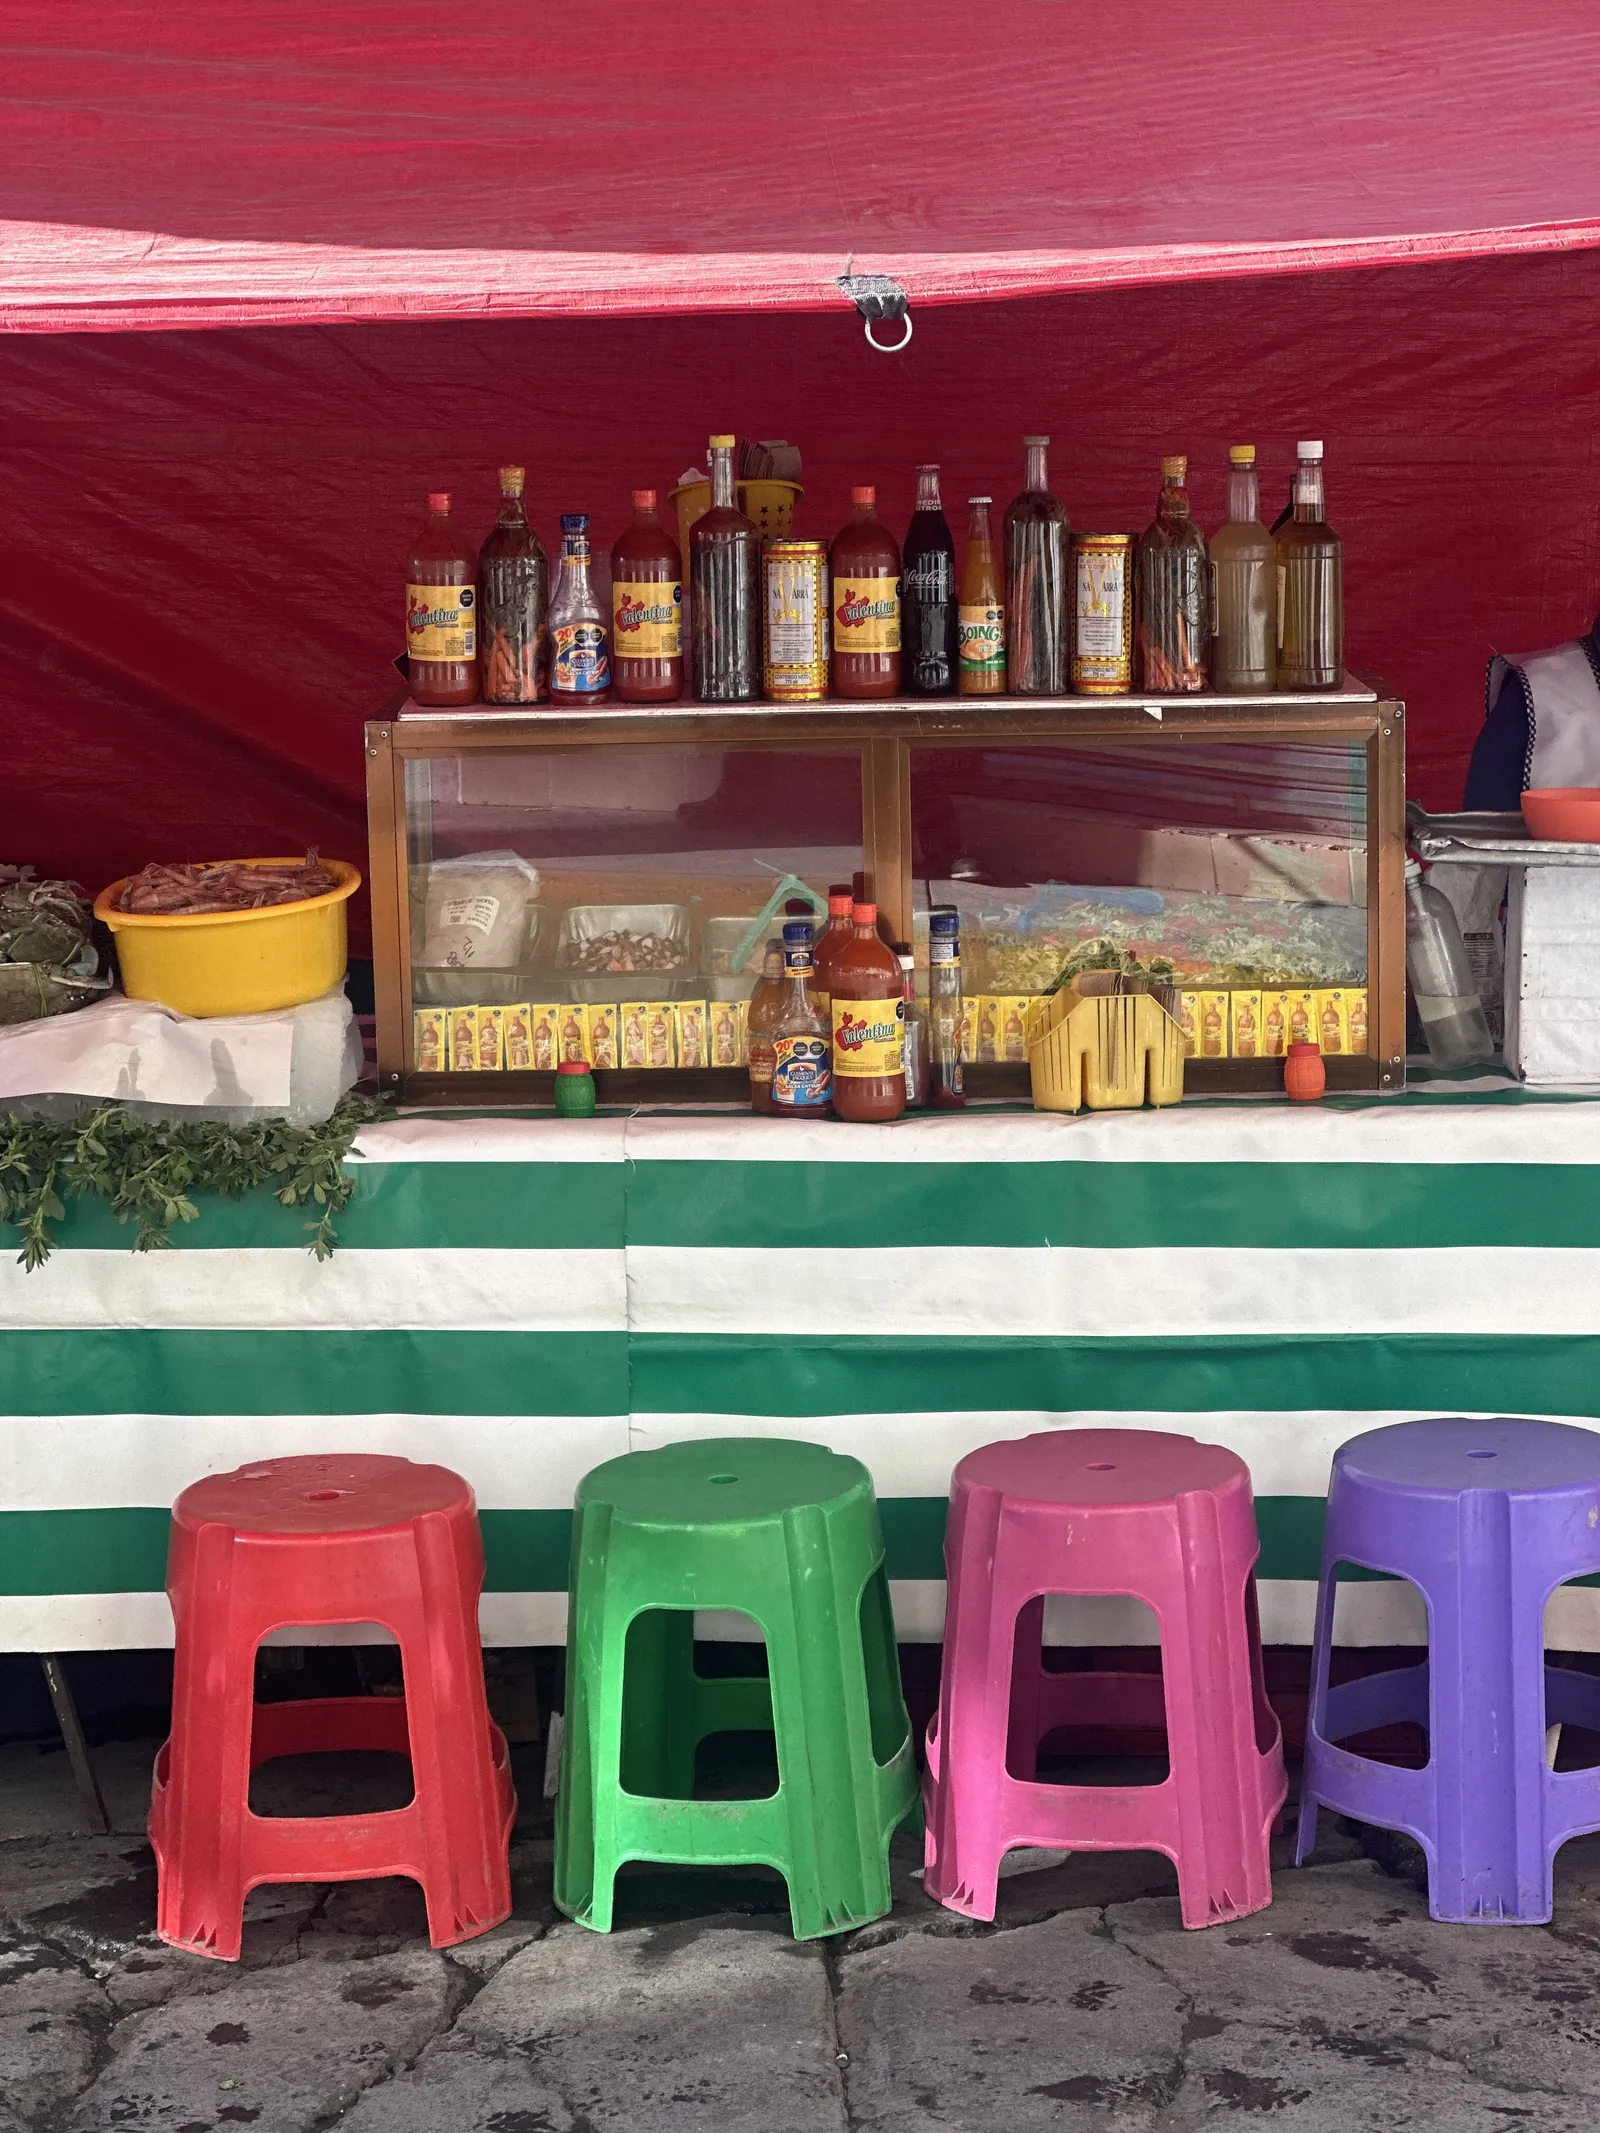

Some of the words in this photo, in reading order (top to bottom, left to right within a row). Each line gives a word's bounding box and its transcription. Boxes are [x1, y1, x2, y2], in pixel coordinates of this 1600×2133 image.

[908, 569, 949, 585] Coca-Cola
[409, 607, 459, 627] Valentina
[620, 604, 673, 626] Valentina
[844, 600, 896, 621] Valentina
[958, 625, 1005, 646] BOING!
[841, 1022, 896, 1045] Valentina
